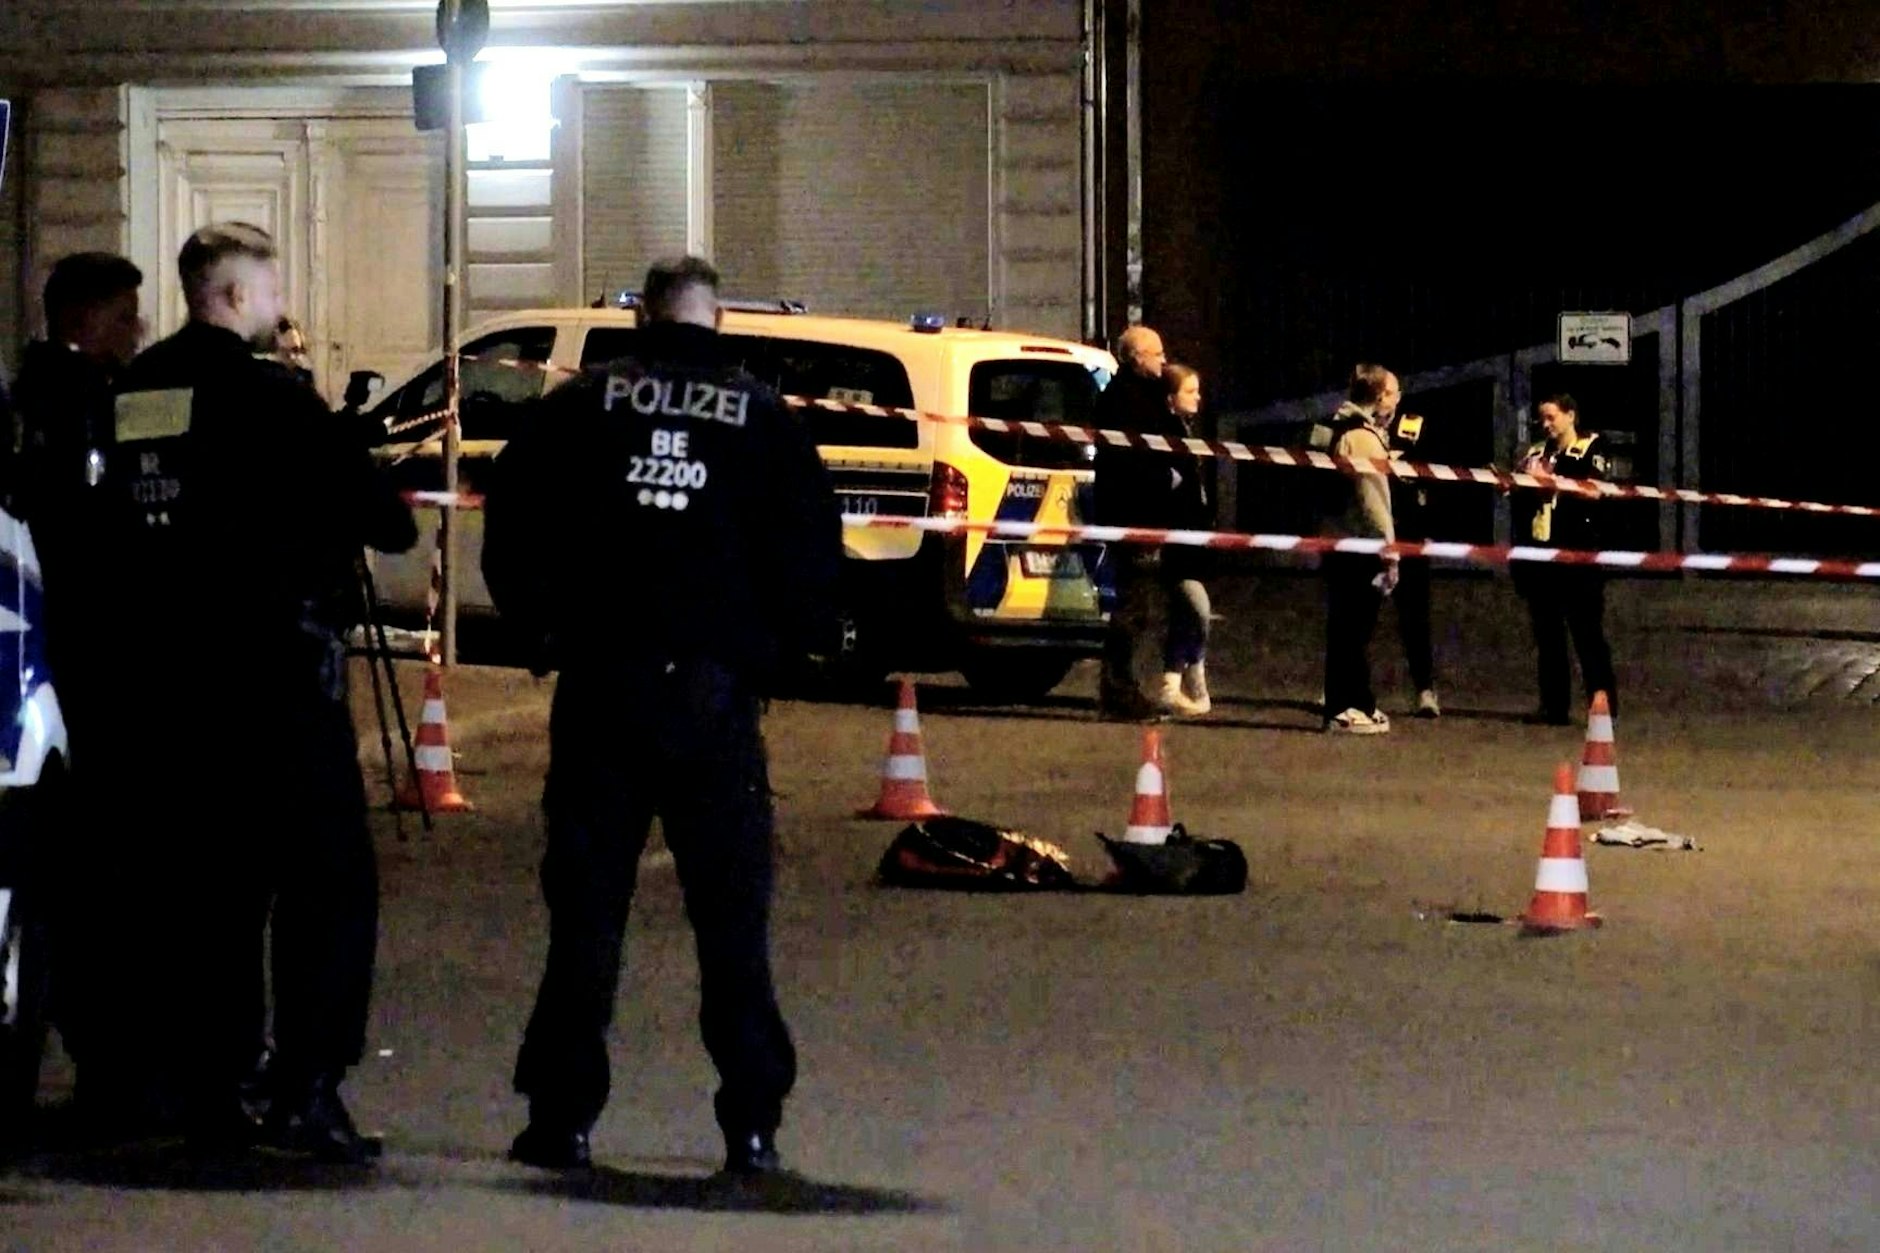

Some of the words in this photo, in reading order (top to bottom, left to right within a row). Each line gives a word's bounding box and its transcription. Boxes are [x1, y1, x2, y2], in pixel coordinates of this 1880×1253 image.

[604, 375, 750, 426] POLIZEI
[651, 428, 689, 458] BE
[626, 455, 707, 489] 22200
